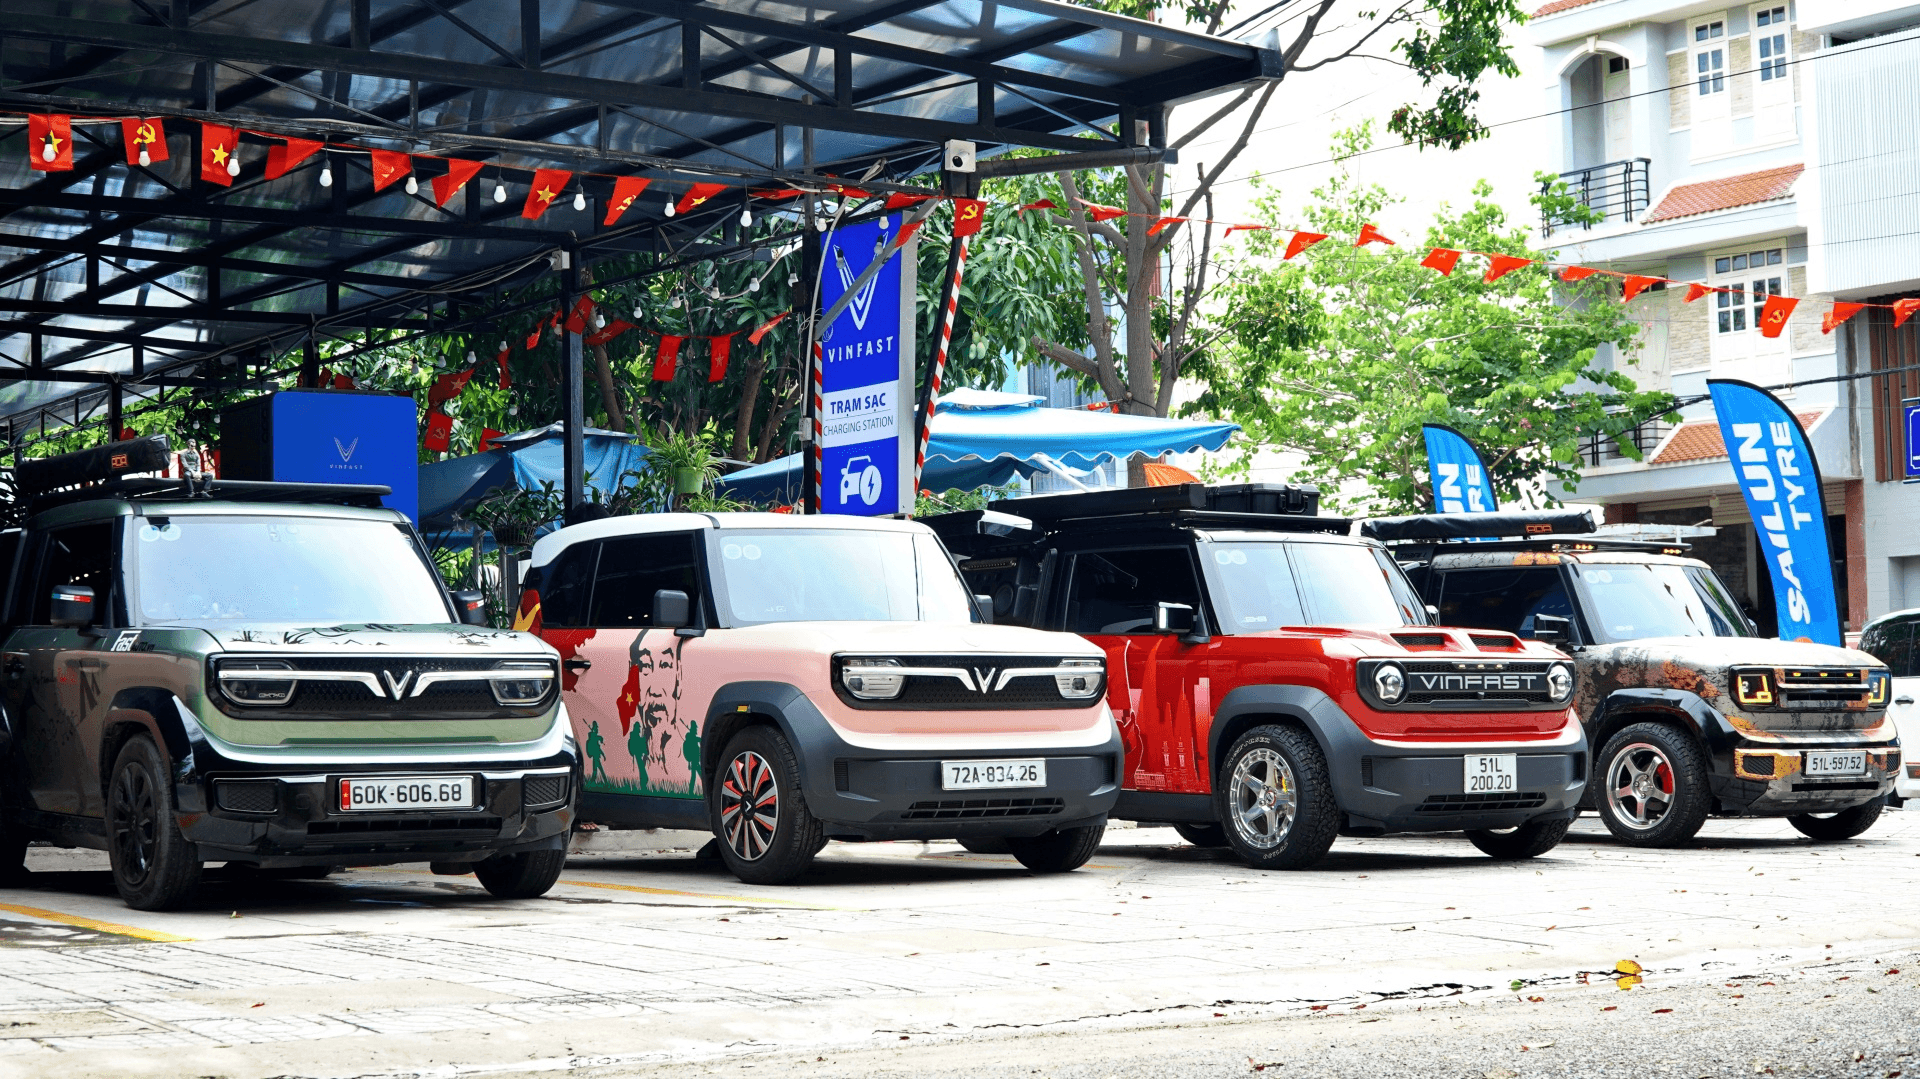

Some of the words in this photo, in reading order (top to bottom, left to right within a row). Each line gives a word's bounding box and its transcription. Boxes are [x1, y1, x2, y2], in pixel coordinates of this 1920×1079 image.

[828, 336, 894, 363] VINFAST
[823, 420, 862, 437] CHARGING
[863, 414, 894, 431] STATION
[1769, 421, 1813, 531] TYRE
[1732, 422, 1811, 625] SAILUN
[1420, 675, 1538, 690] VINFAST
[952, 764, 1037, 784] 72A-834.26
[1480, 757, 1503, 773] 51L
[1812, 756, 1862, 771] 51L-597.52
[1471, 774, 1512, 791] 200.20
[352, 783, 463, 805] 60K-606.68
